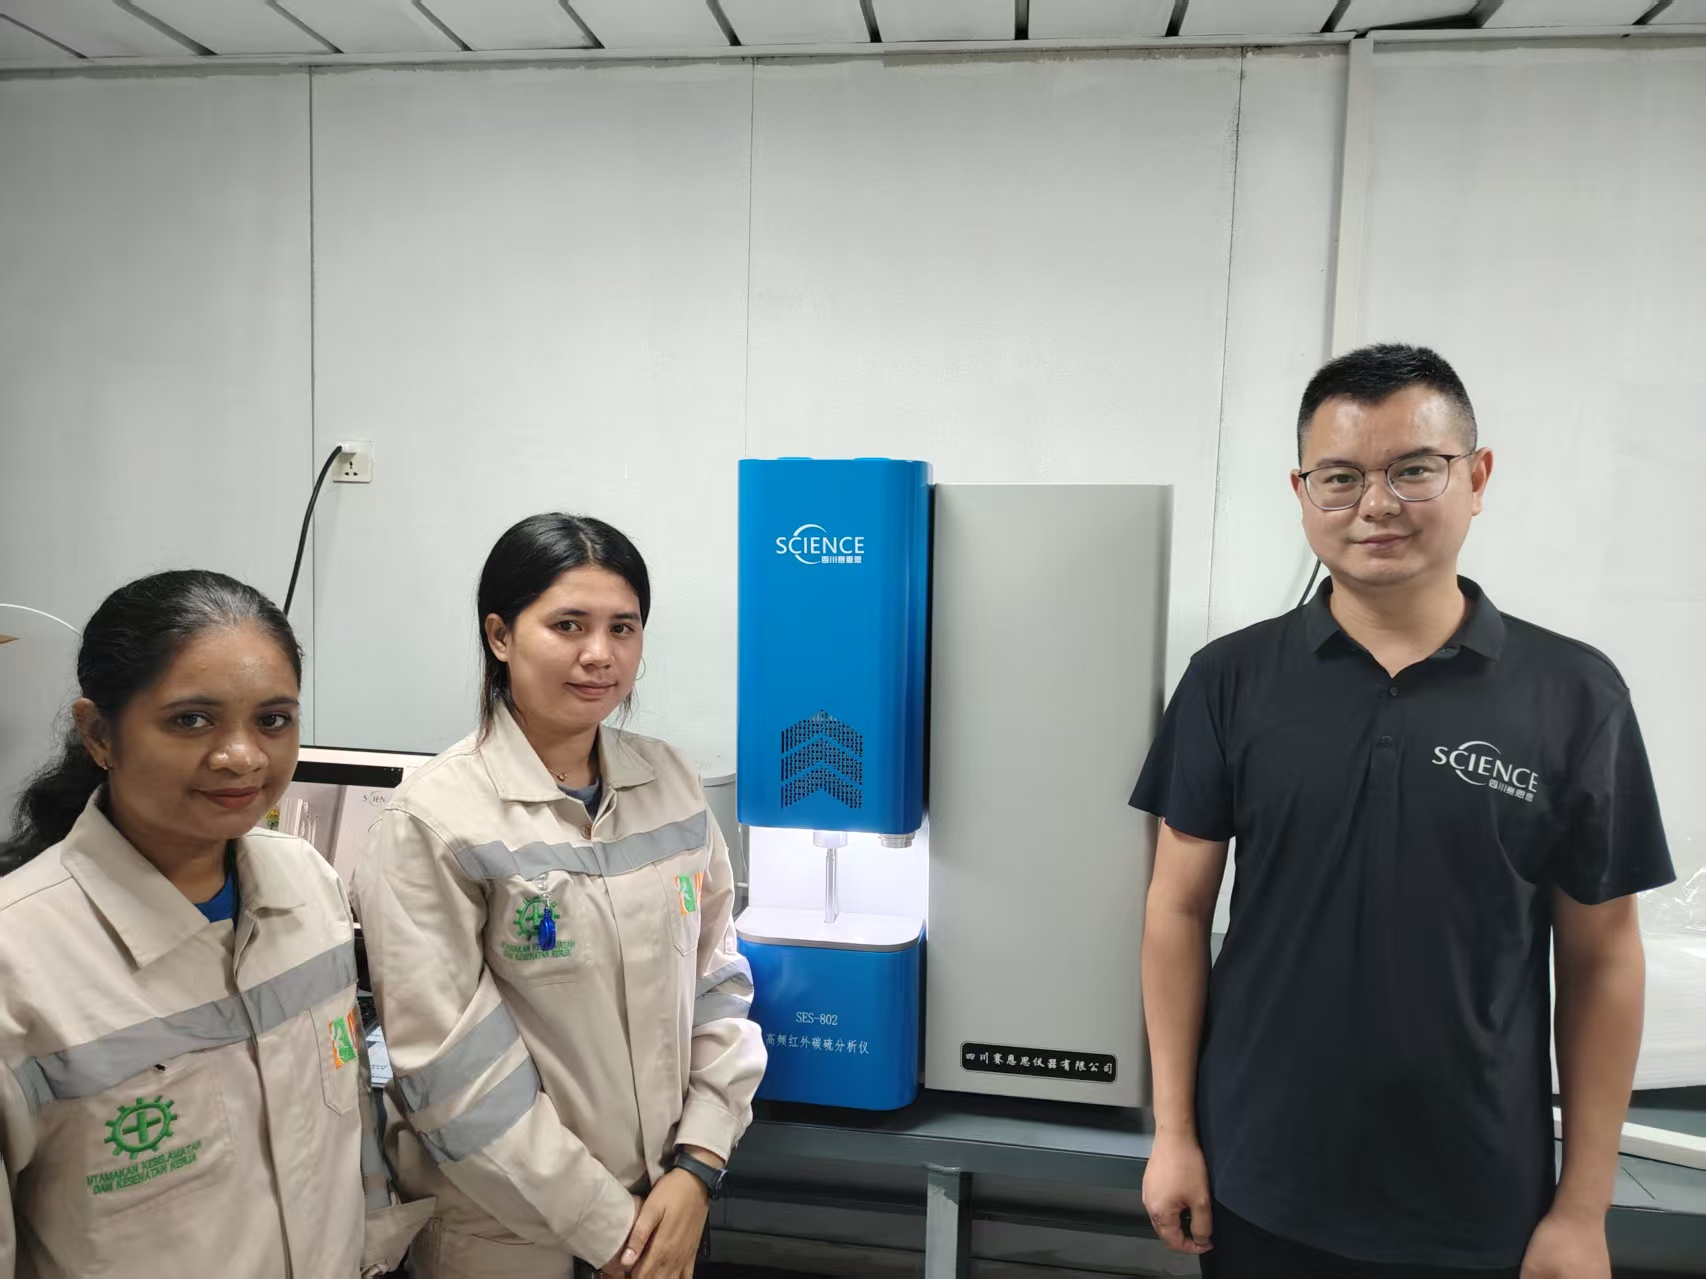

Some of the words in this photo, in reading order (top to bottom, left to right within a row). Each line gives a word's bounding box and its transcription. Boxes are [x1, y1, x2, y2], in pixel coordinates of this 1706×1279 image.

[776, 536, 864, 554] SCIENCE
[1431, 746, 1539, 792] SCIENCE
[796, 1011, 838, 1026] SES-802
[765, 1033, 869, 1054] 高频红外碳硫分析仪
[965, 1051, 1113, 1075] 四川赛恩思仪器有限公司
